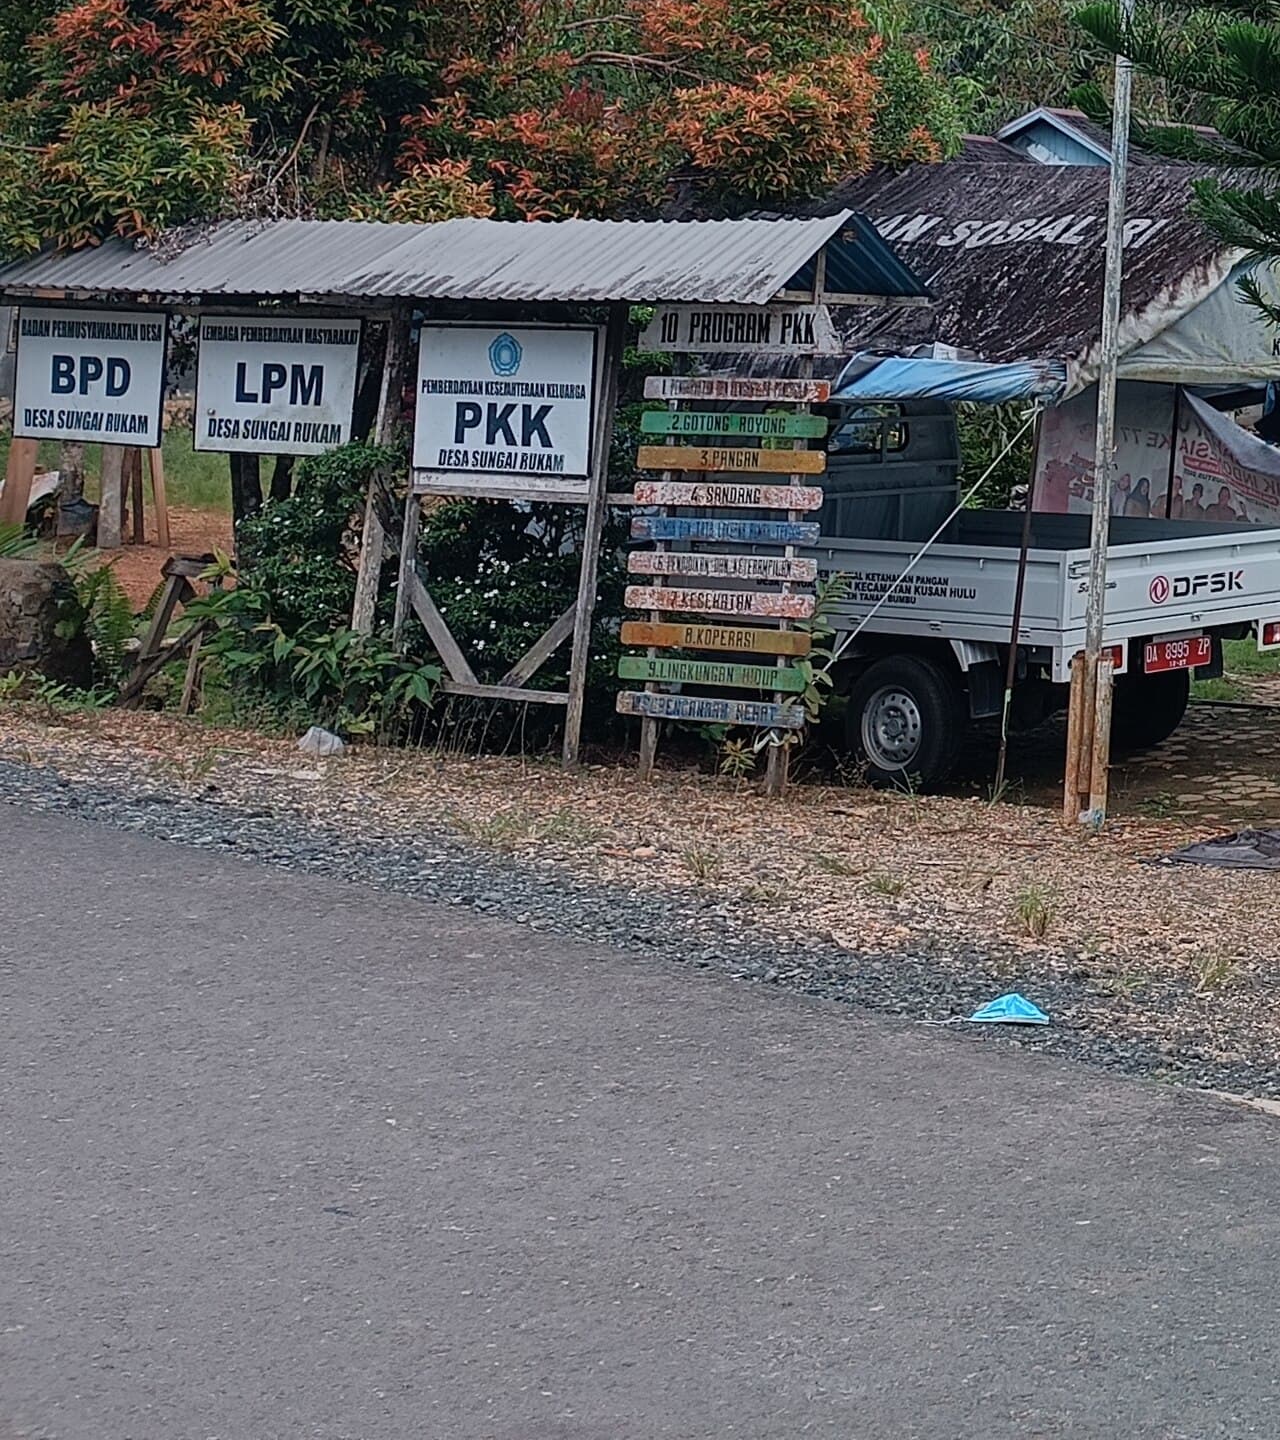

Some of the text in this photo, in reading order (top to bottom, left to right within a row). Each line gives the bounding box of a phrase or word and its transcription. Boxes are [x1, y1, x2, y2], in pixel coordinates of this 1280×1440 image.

[936, 215, 1098, 248] SOSIAL
[21, 319, 50, 337] BADAN
[140, 324, 162, 341] DESA
[202, 325, 359, 345] LEMBAGA PEMBERDAYAAN MASYARAKAT
[660, 313, 816, 345] 10 PROGRAM PKK
[51, 354, 131, 397] BPD
[235, 362, 324, 406] LPM
[422, 379, 484, 395] PEMBERDAYAAN
[546, 383, 586, 399] KELUARGA
[24, 409, 148, 434] DESA SUNGAI RUKAM
[208, 418, 341, 444] DESA SUNGAI RUKAM
[454, 401, 554, 448] PKK
[739, 416, 786, 434] ROYONG
[438, 449, 565, 472] DESA SUNGAI RUKAM
[700, 450, 759, 468] 3.PANGAN
[706, 486, 761, 504] SANDANG
[914, 585, 947, 597] KUSAN
[949, 588, 976, 599] HULU
[916, 576, 949, 586] PANGAN
[1173, 570, 1245, 598] DFSK
[685, 627, 756, 648] 8.KOPERASI
[1146, 638, 1210, 663] DA 8995 ZP
[648, 661, 734, 682] 9.LINGKUNGAN
